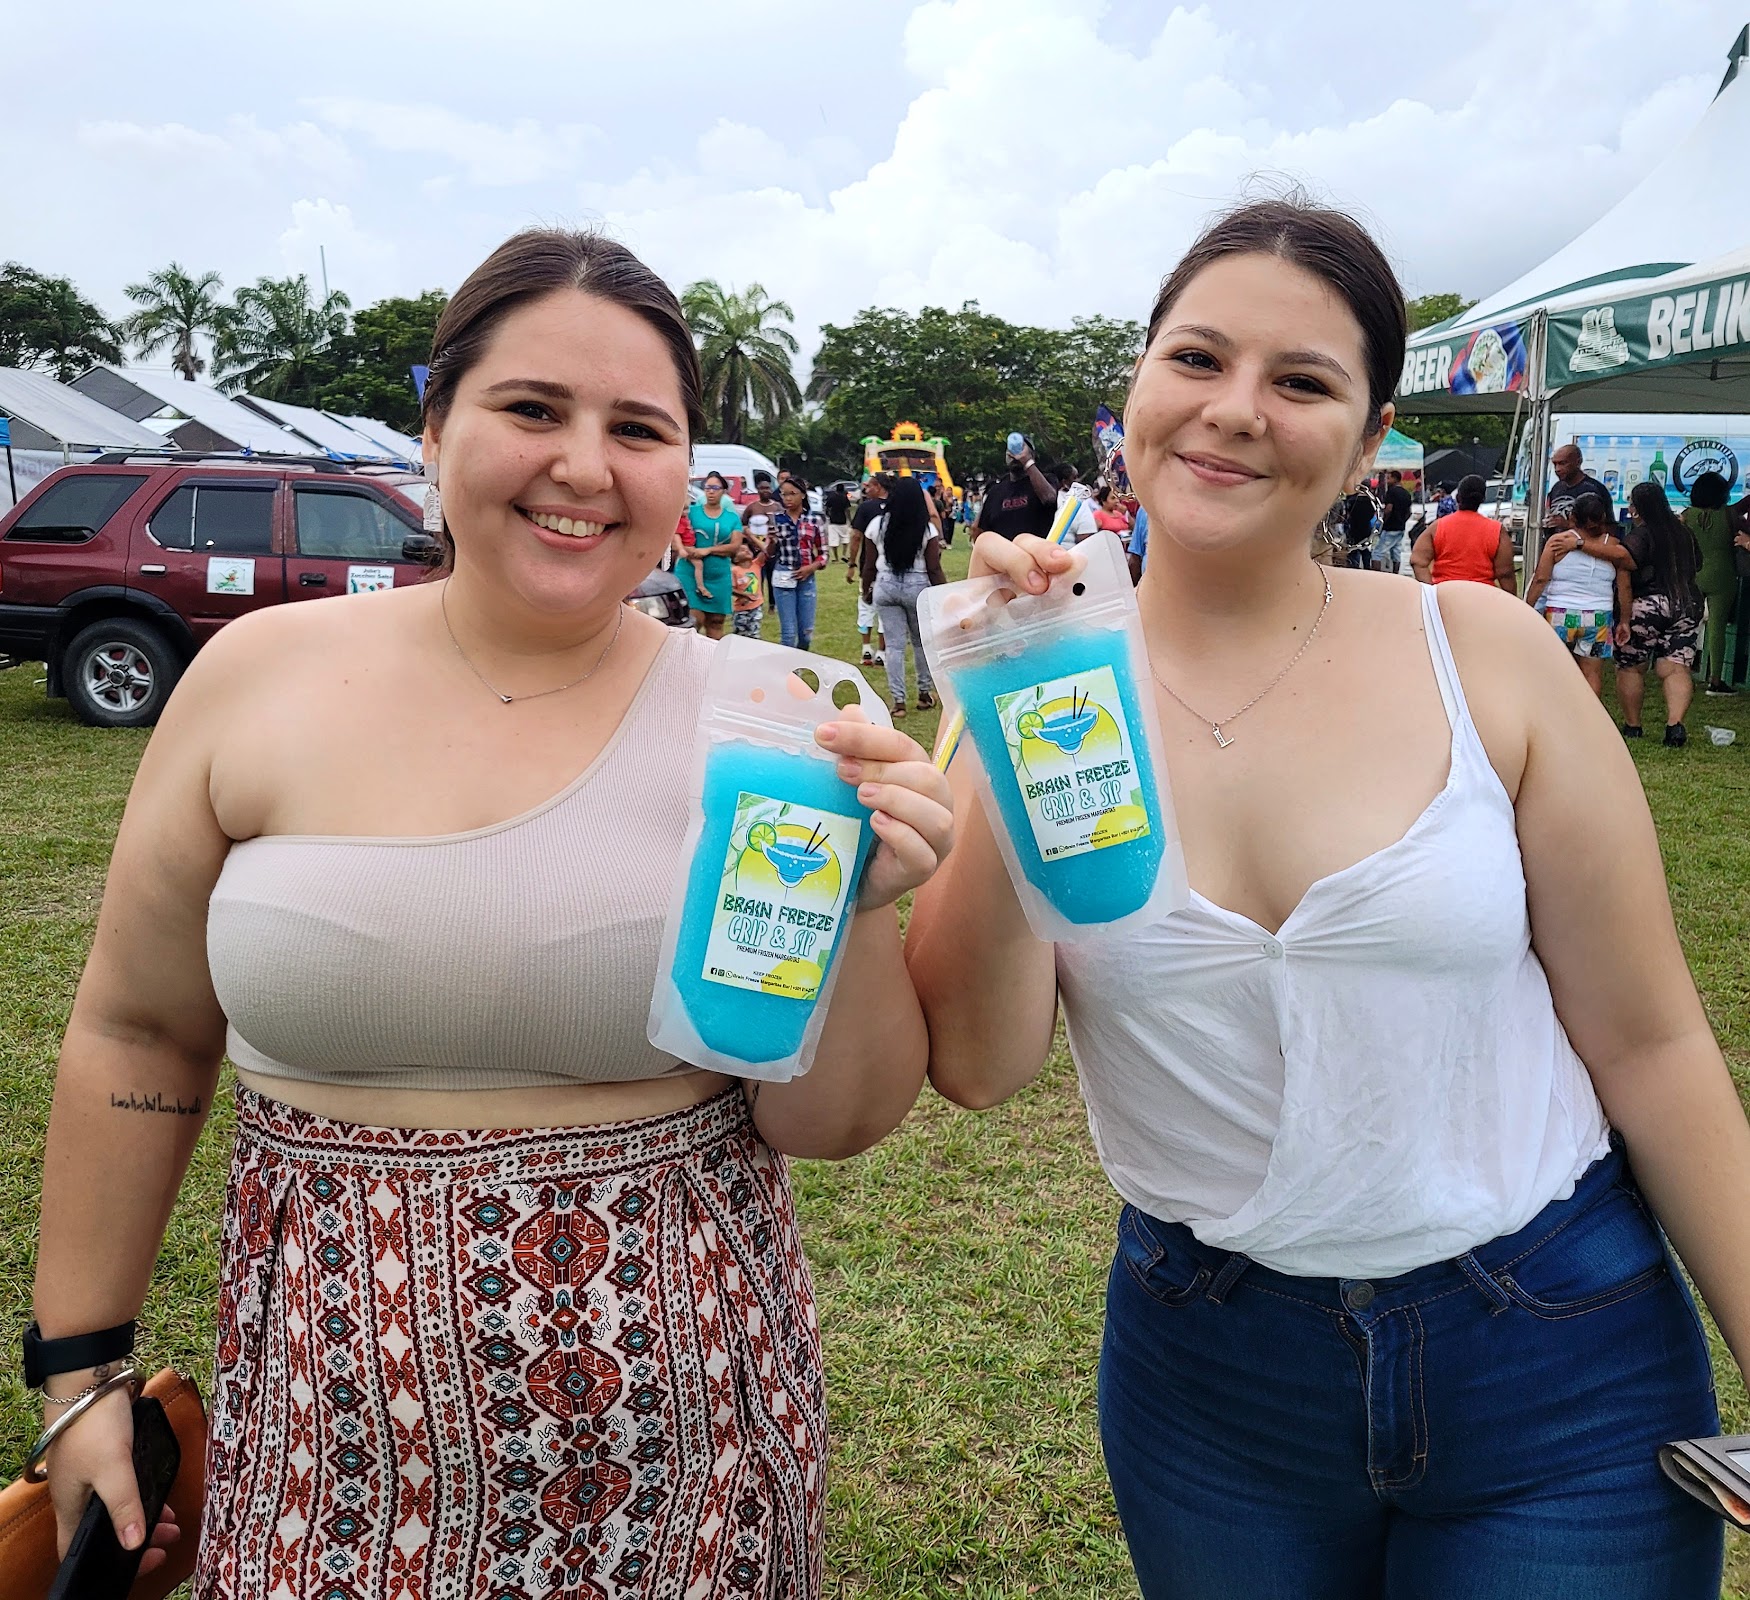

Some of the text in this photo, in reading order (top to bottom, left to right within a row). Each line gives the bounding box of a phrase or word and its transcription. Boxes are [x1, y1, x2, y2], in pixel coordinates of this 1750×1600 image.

[1400, 345, 1452, 397] BEER
[1025, 760, 1131, 800] BRAIN FREEZE
[1041, 780, 1122, 821] GRIP & SIP
[1056, 807, 1116, 827] PREMIUM FROZEN MARGARITAS
[1091, 829, 1108, 837] FROZEN
[723, 893, 834, 932] BRAIN FREEZE
[728, 916, 817, 957] GRIP & SIP
[736, 944, 800, 964] PREMIUM FROZEN MARGARITAS
[765, 972, 782, 980] FROZEN
